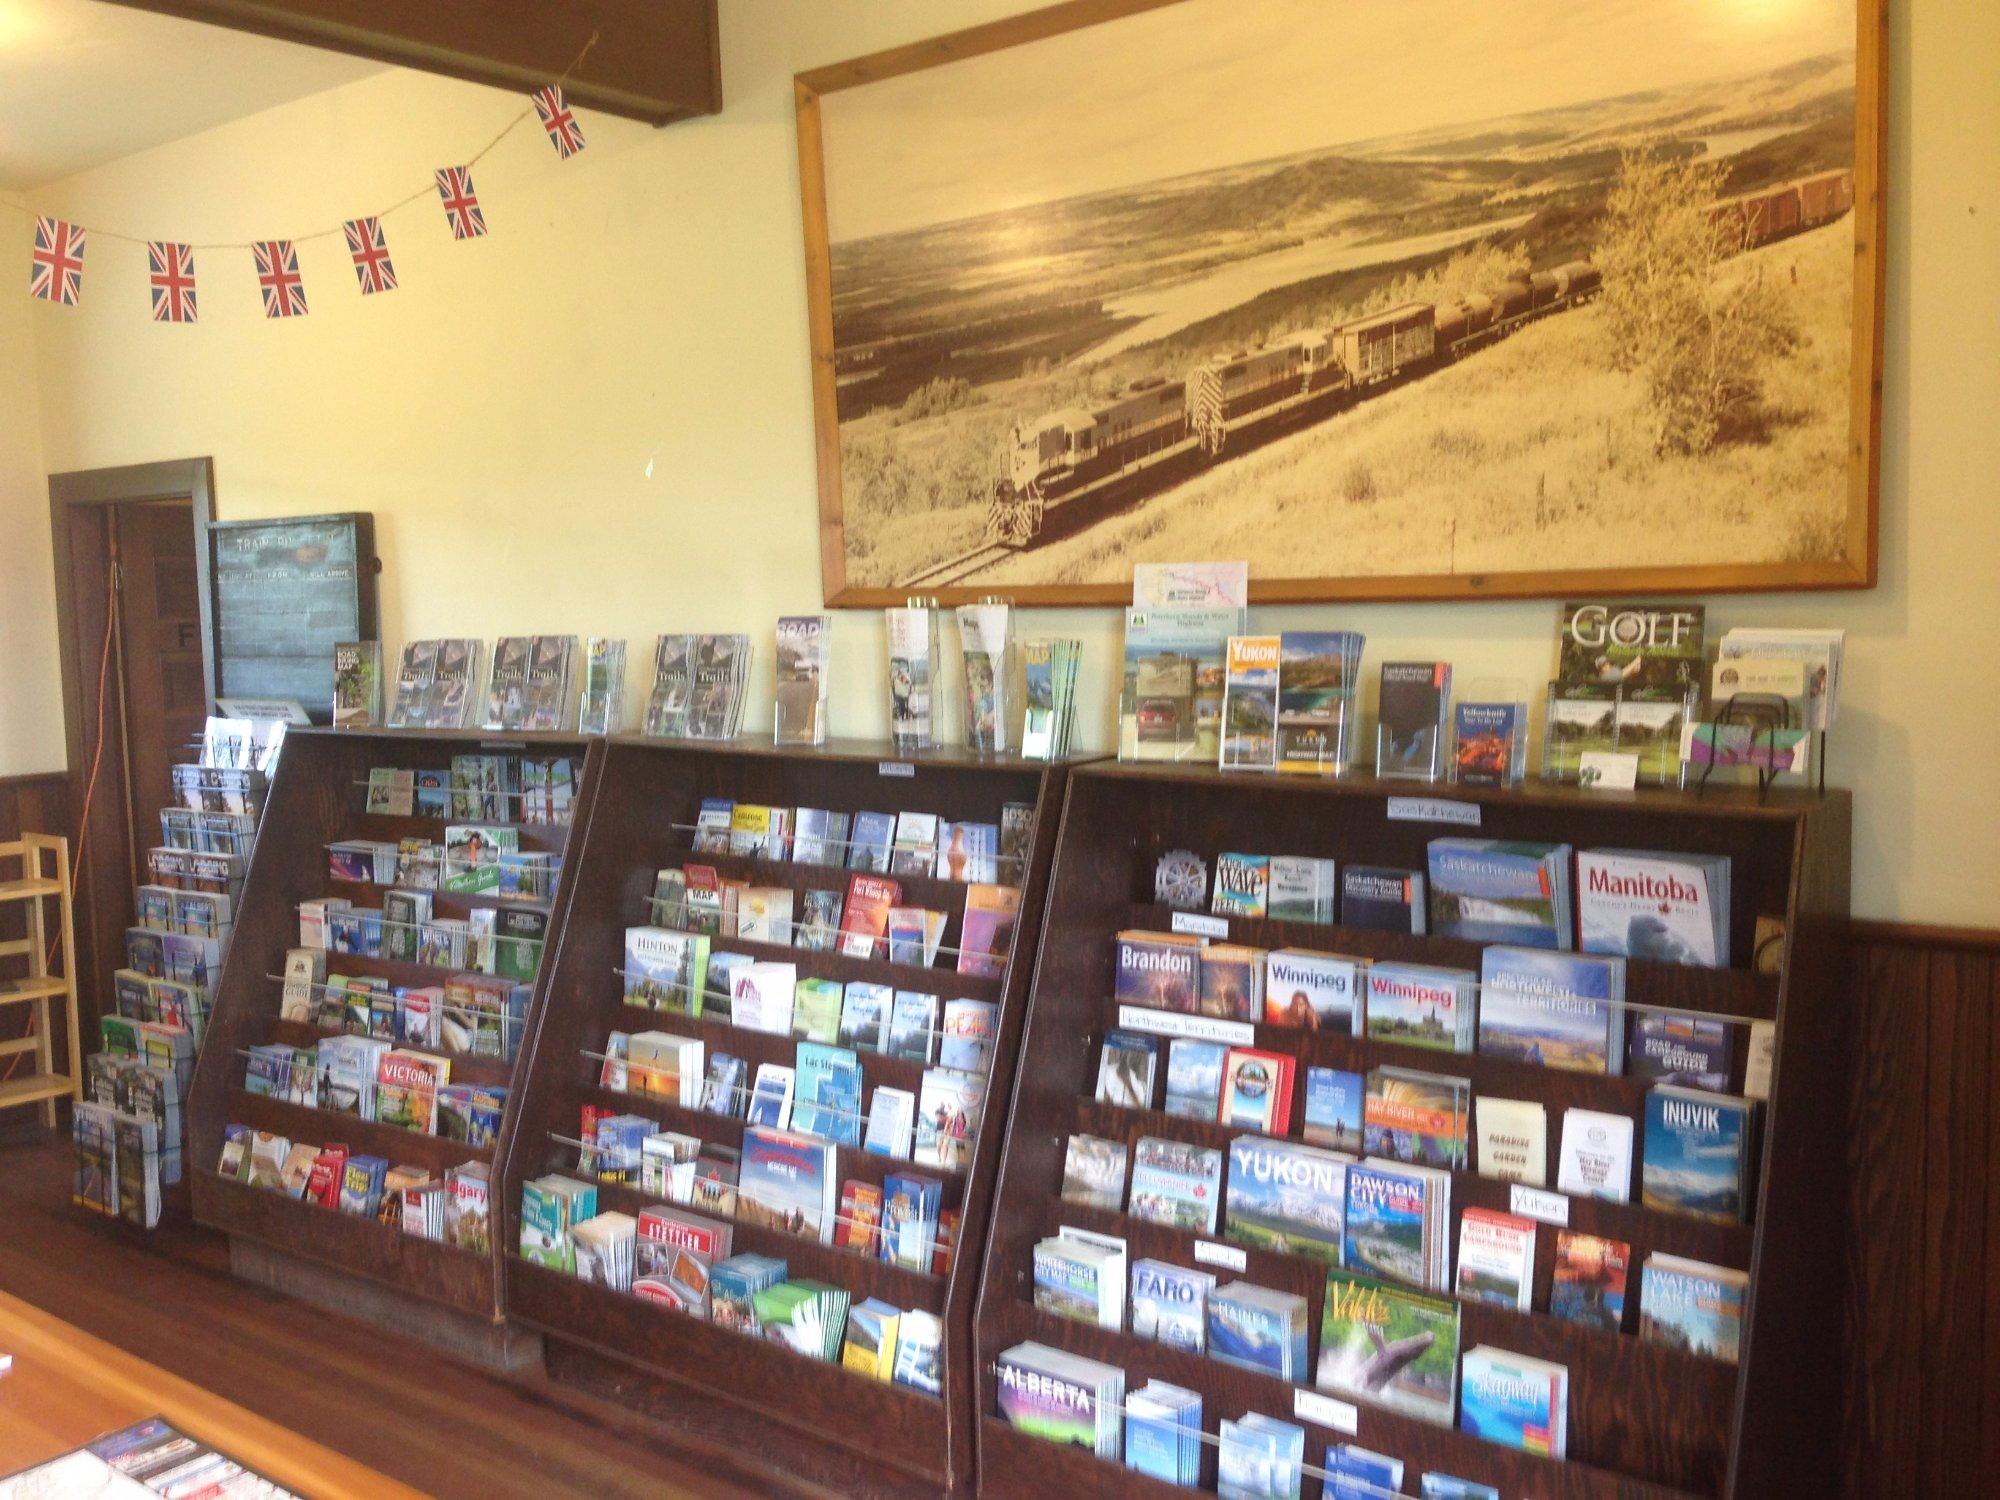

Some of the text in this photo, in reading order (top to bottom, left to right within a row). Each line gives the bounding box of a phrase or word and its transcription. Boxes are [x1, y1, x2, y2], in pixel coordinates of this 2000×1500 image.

[1570, 605, 1692, 649] GOLF
[1232, 640, 1277, 662] YUKON
[699, 672, 729, 683] Trails
[1391, 799, 1480, 824] Saskatchewan
[692, 890, 714, 901] MAP
[1589, 865, 1699, 904] Manitoba
[637, 936, 678, 954] HINTON
[1121, 945, 1192, 973] Brandon
[1272, 963, 1347, 991] Winnipeg
[1371, 976, 1453, 1008] Winnipeg
[384, 1062, 434, 1088] VICTORIA
[1387, 1104, 1416, 1121] RIVER
[1663, 1100, 1720, 1131] INUVIK
[1236, 1147, 1333, 1192] YUKON
[1351, 1172, 1419, 1201] DAWSON
[648, 1222, 700, 1252] STETTLER
[1034, 1252, 1097, 1281] WHITEHORSE
[1138, 1270, 1195, 1302] FARO
[1651, 1269, 1721, 1299] WATSON
[1218, 1301, 1270, 1330] HAINES
[1002, 1363, 1091, 1414] ALBERTA
